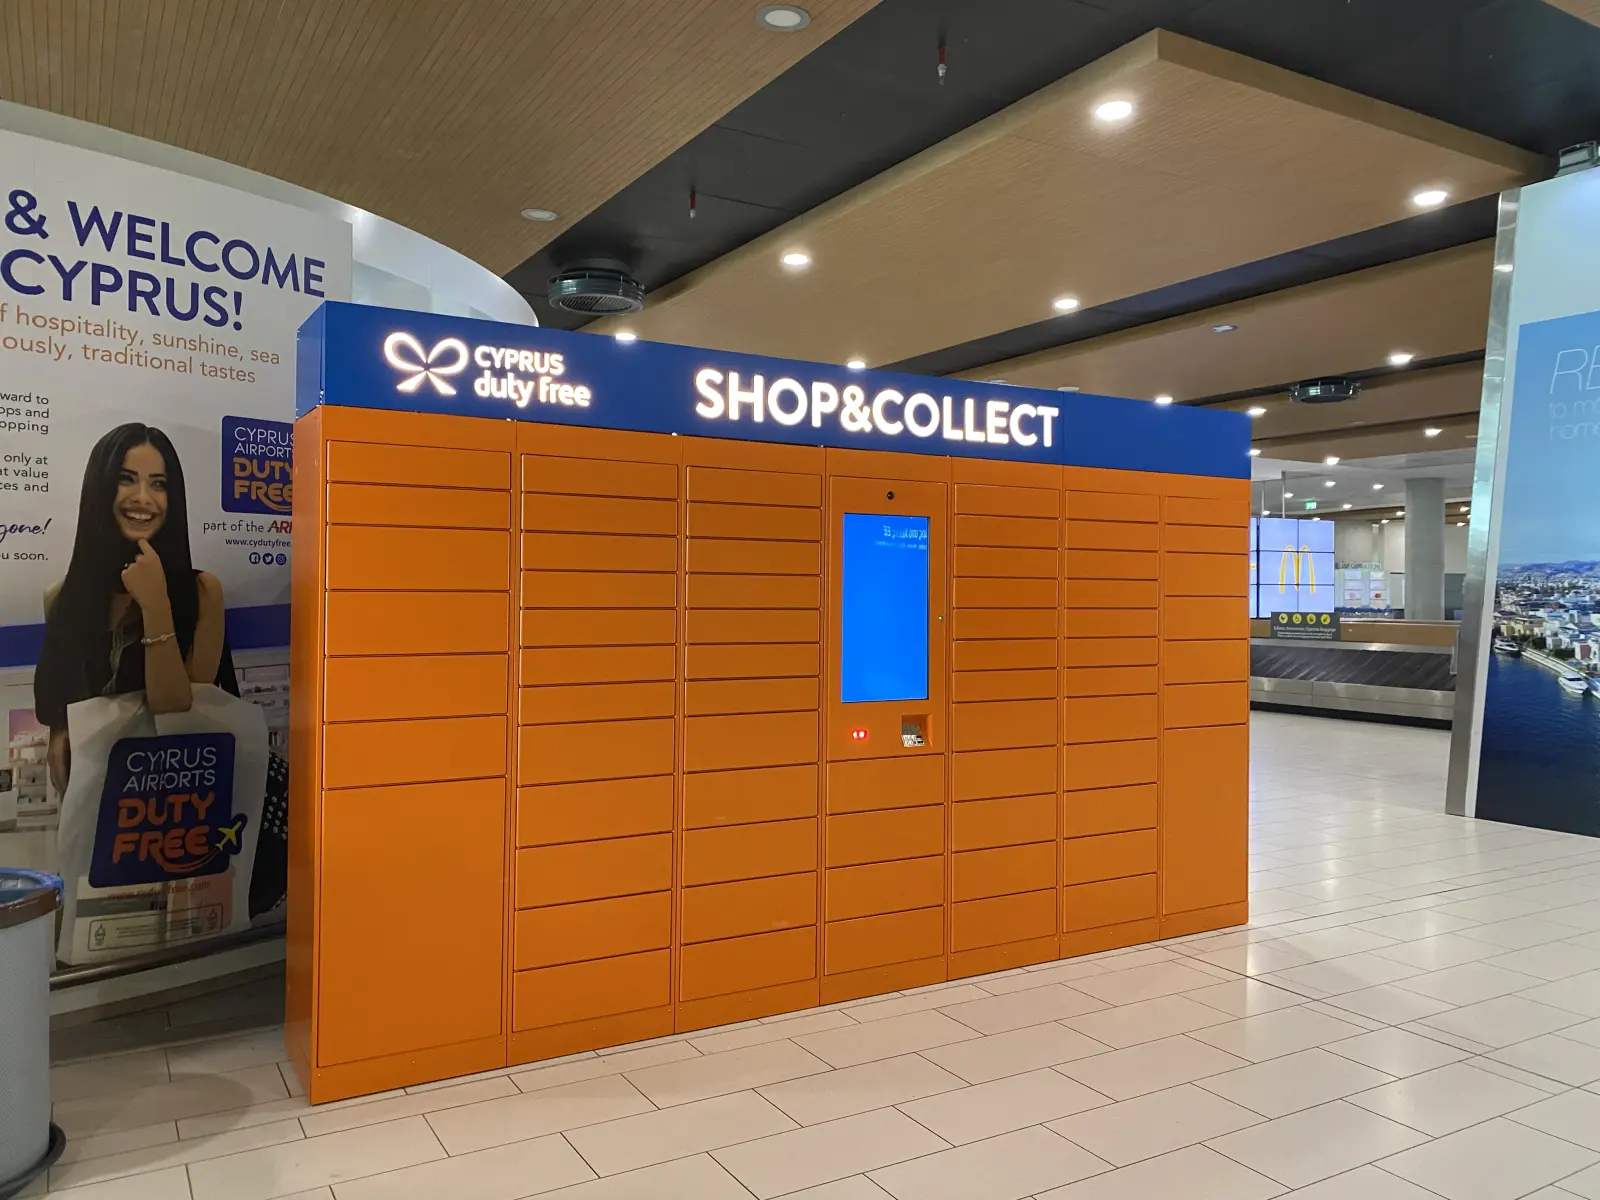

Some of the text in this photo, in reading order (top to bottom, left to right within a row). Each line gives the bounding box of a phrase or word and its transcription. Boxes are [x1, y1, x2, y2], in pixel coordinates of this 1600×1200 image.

[5, 189, 326, 298] & WELCOME
[0, 249, 243, 331] CYPRUS!
[16, 304, 144, 346] hospitality,
[152, 331, 243, 361] sunshine,
[250, 349, 280, 365] sea
[81, 343, 193, 374] traditional
[199, 361, 256, 383] tastes
[474, 344, 565, 376] CYPRUS
[0, 392, 49, 405] ward to
[474, 370, 592, 408] duty free
[25, 408, 50, 419] and
[693, 366, 1060, 449] SHOP&COLLECT
[0, 420, 49, 435] opping
[4, 452, 49, 466] only at
[234, 442, 294, 459] AIRPORT
[13, 467, 49, 479] value
[24, 482, 49, 493] and
[203, 521, 227, 535] part
[231, 519, 243, 532] of
[246, 520, 264, 533] the
[13, 552, 49, 561] soon.
[117, 790, 216, 829] DUTY
[112, 824, 211, 869] FREE
